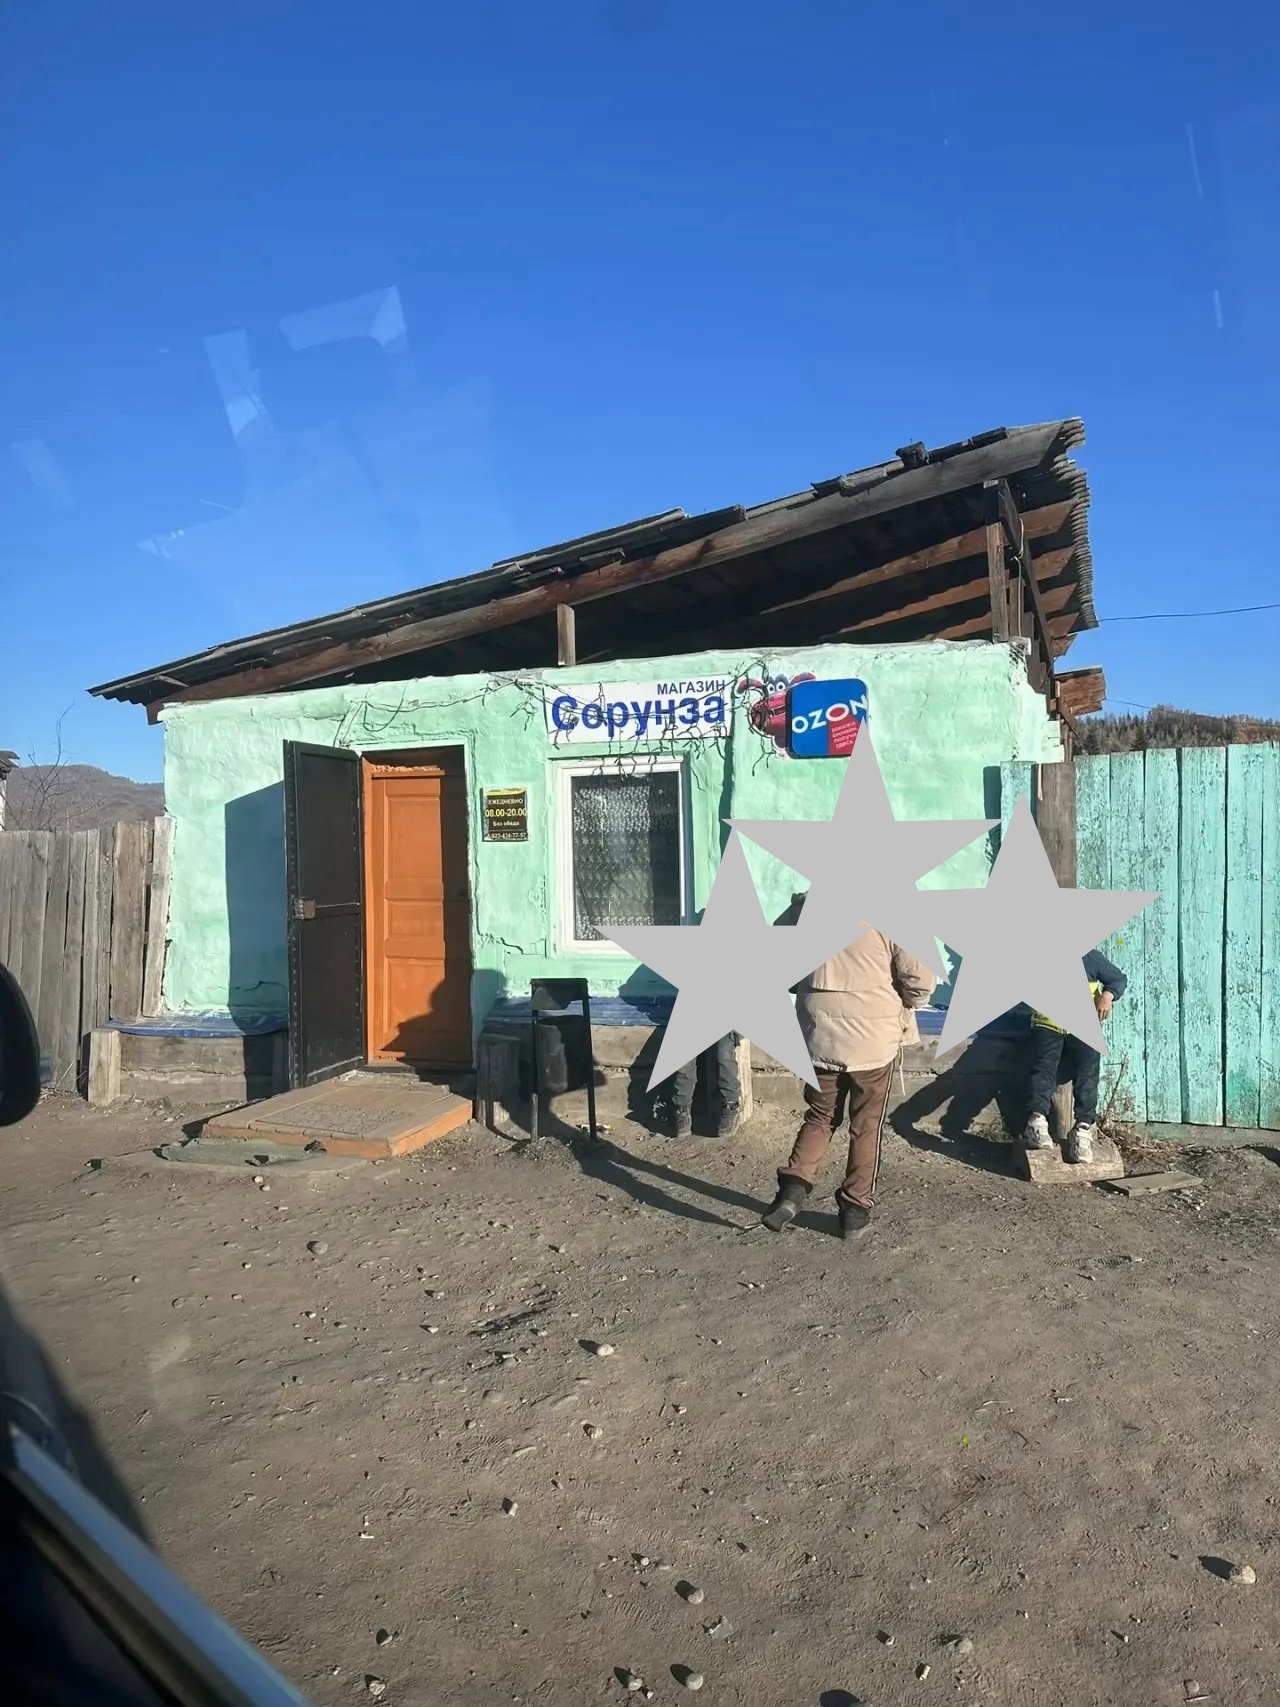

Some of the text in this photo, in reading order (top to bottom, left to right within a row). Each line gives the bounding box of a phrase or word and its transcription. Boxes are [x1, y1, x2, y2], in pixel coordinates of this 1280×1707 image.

[657, 680, 726, 696] МАГАЗИН
[552, 694, 726, 738] Сорунза
[792, 695, 868, 734] OZON
[484, 808, 528, 818] 08.00-20.00
